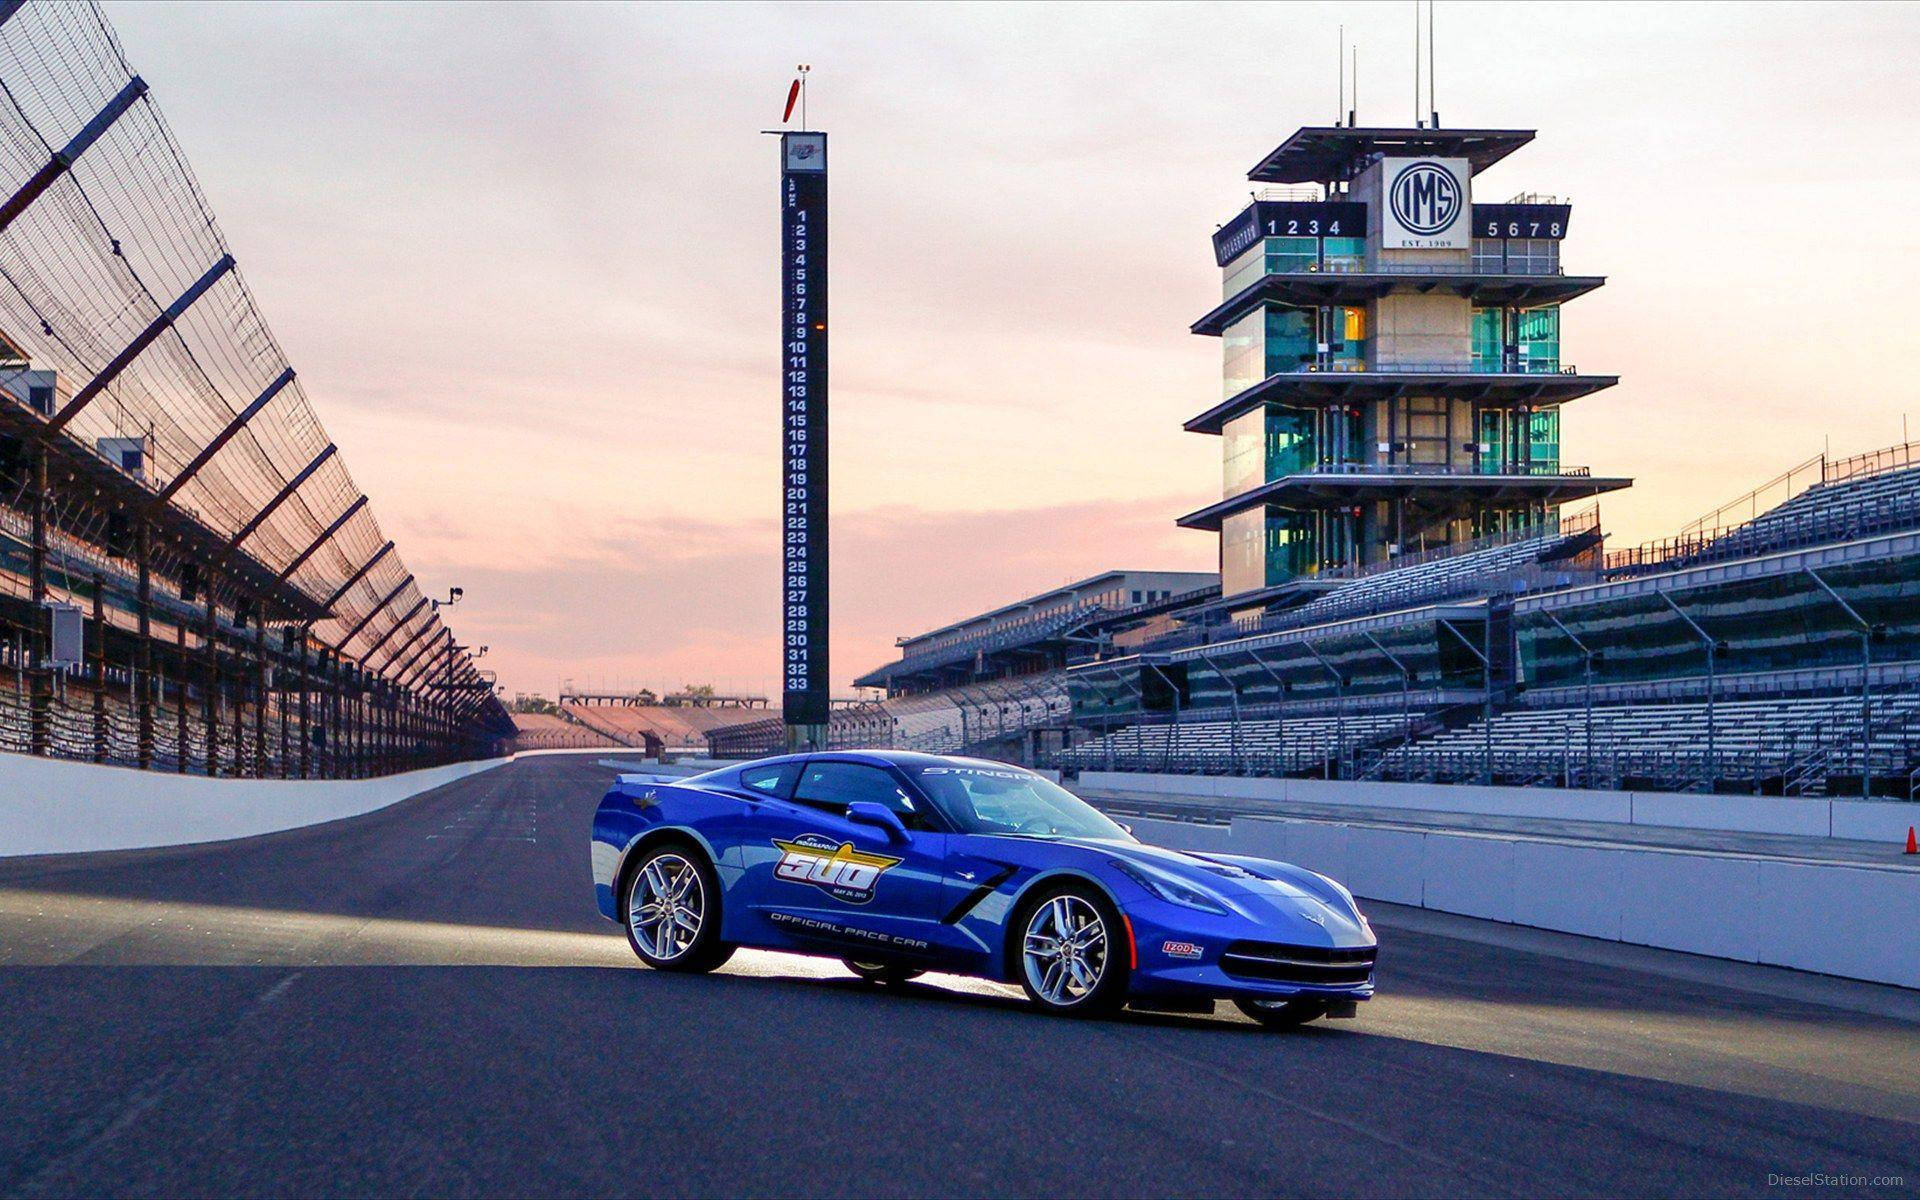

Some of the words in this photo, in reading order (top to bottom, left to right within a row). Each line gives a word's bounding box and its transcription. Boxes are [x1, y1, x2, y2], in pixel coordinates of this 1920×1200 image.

[1403, 172, 1453, 226] IMS
[797, 210, 806, 222] 1
[795, 224, 806, 236] 2
[1268, 219, 1276, 235] 1
[1287, 220, 1298, 235] 2
[1308, 219, 1319, 235] 3
[1329, 220, 1340, 235] 4
[1488, 222, 1498, 237] 5
[1508, 222, 1519, 237] 6
[1529, 222, 1540, 237] 7
[1550, 222, 1560, 237] 8
[795, 239, 806, 251] 3
[795, 254, 806, 266] 4
[796, 268, 806, 281] 5
[796, 283, 806, 295] 6
[796, 297, 806, 310] 7
[796, 312, 806, 324] 8
[796, 326, 806, 339] 9
[788, 341, 807, 354] 10
[789, 356, 807, 368] 11
[788, 370, 807, 383] 12
[788, 385, 807, 398] 13
[788, 400, 807, 412] 14
[788, 414, 807, 427] 15
[788, 429, 807, 441] 16
[788, 444, 807, 456] 17
[788, 458, 807, 471] 18
[788, 473, 807, 485] 19
[787, 487, 807, 500] 20
[787, 502, 807, 515] 21
[787, 517, 807, 529] 22
[787, 531, 807, 544] 23
[786, 546, 807, 559] 24
[788, 560, 807, 573] 25
[788, 575, 807, 588] 26
[788, 590, 807, 602] 27
[787, 605, 808, 617] 28
[787, 619, 807, 632] 29
[787, 634, 807, 646] 30
[788, 648, 807, 661] 31
[788, 663, 808, 675] 32
[788, 677, 807, 690] 33
[770, 912, 842, 933] OFFICIAL
[844, 927, 890, 942] PACE
[893, 936, 928, 949] CAR
[1165, 943, 1191, 952] IZOD
